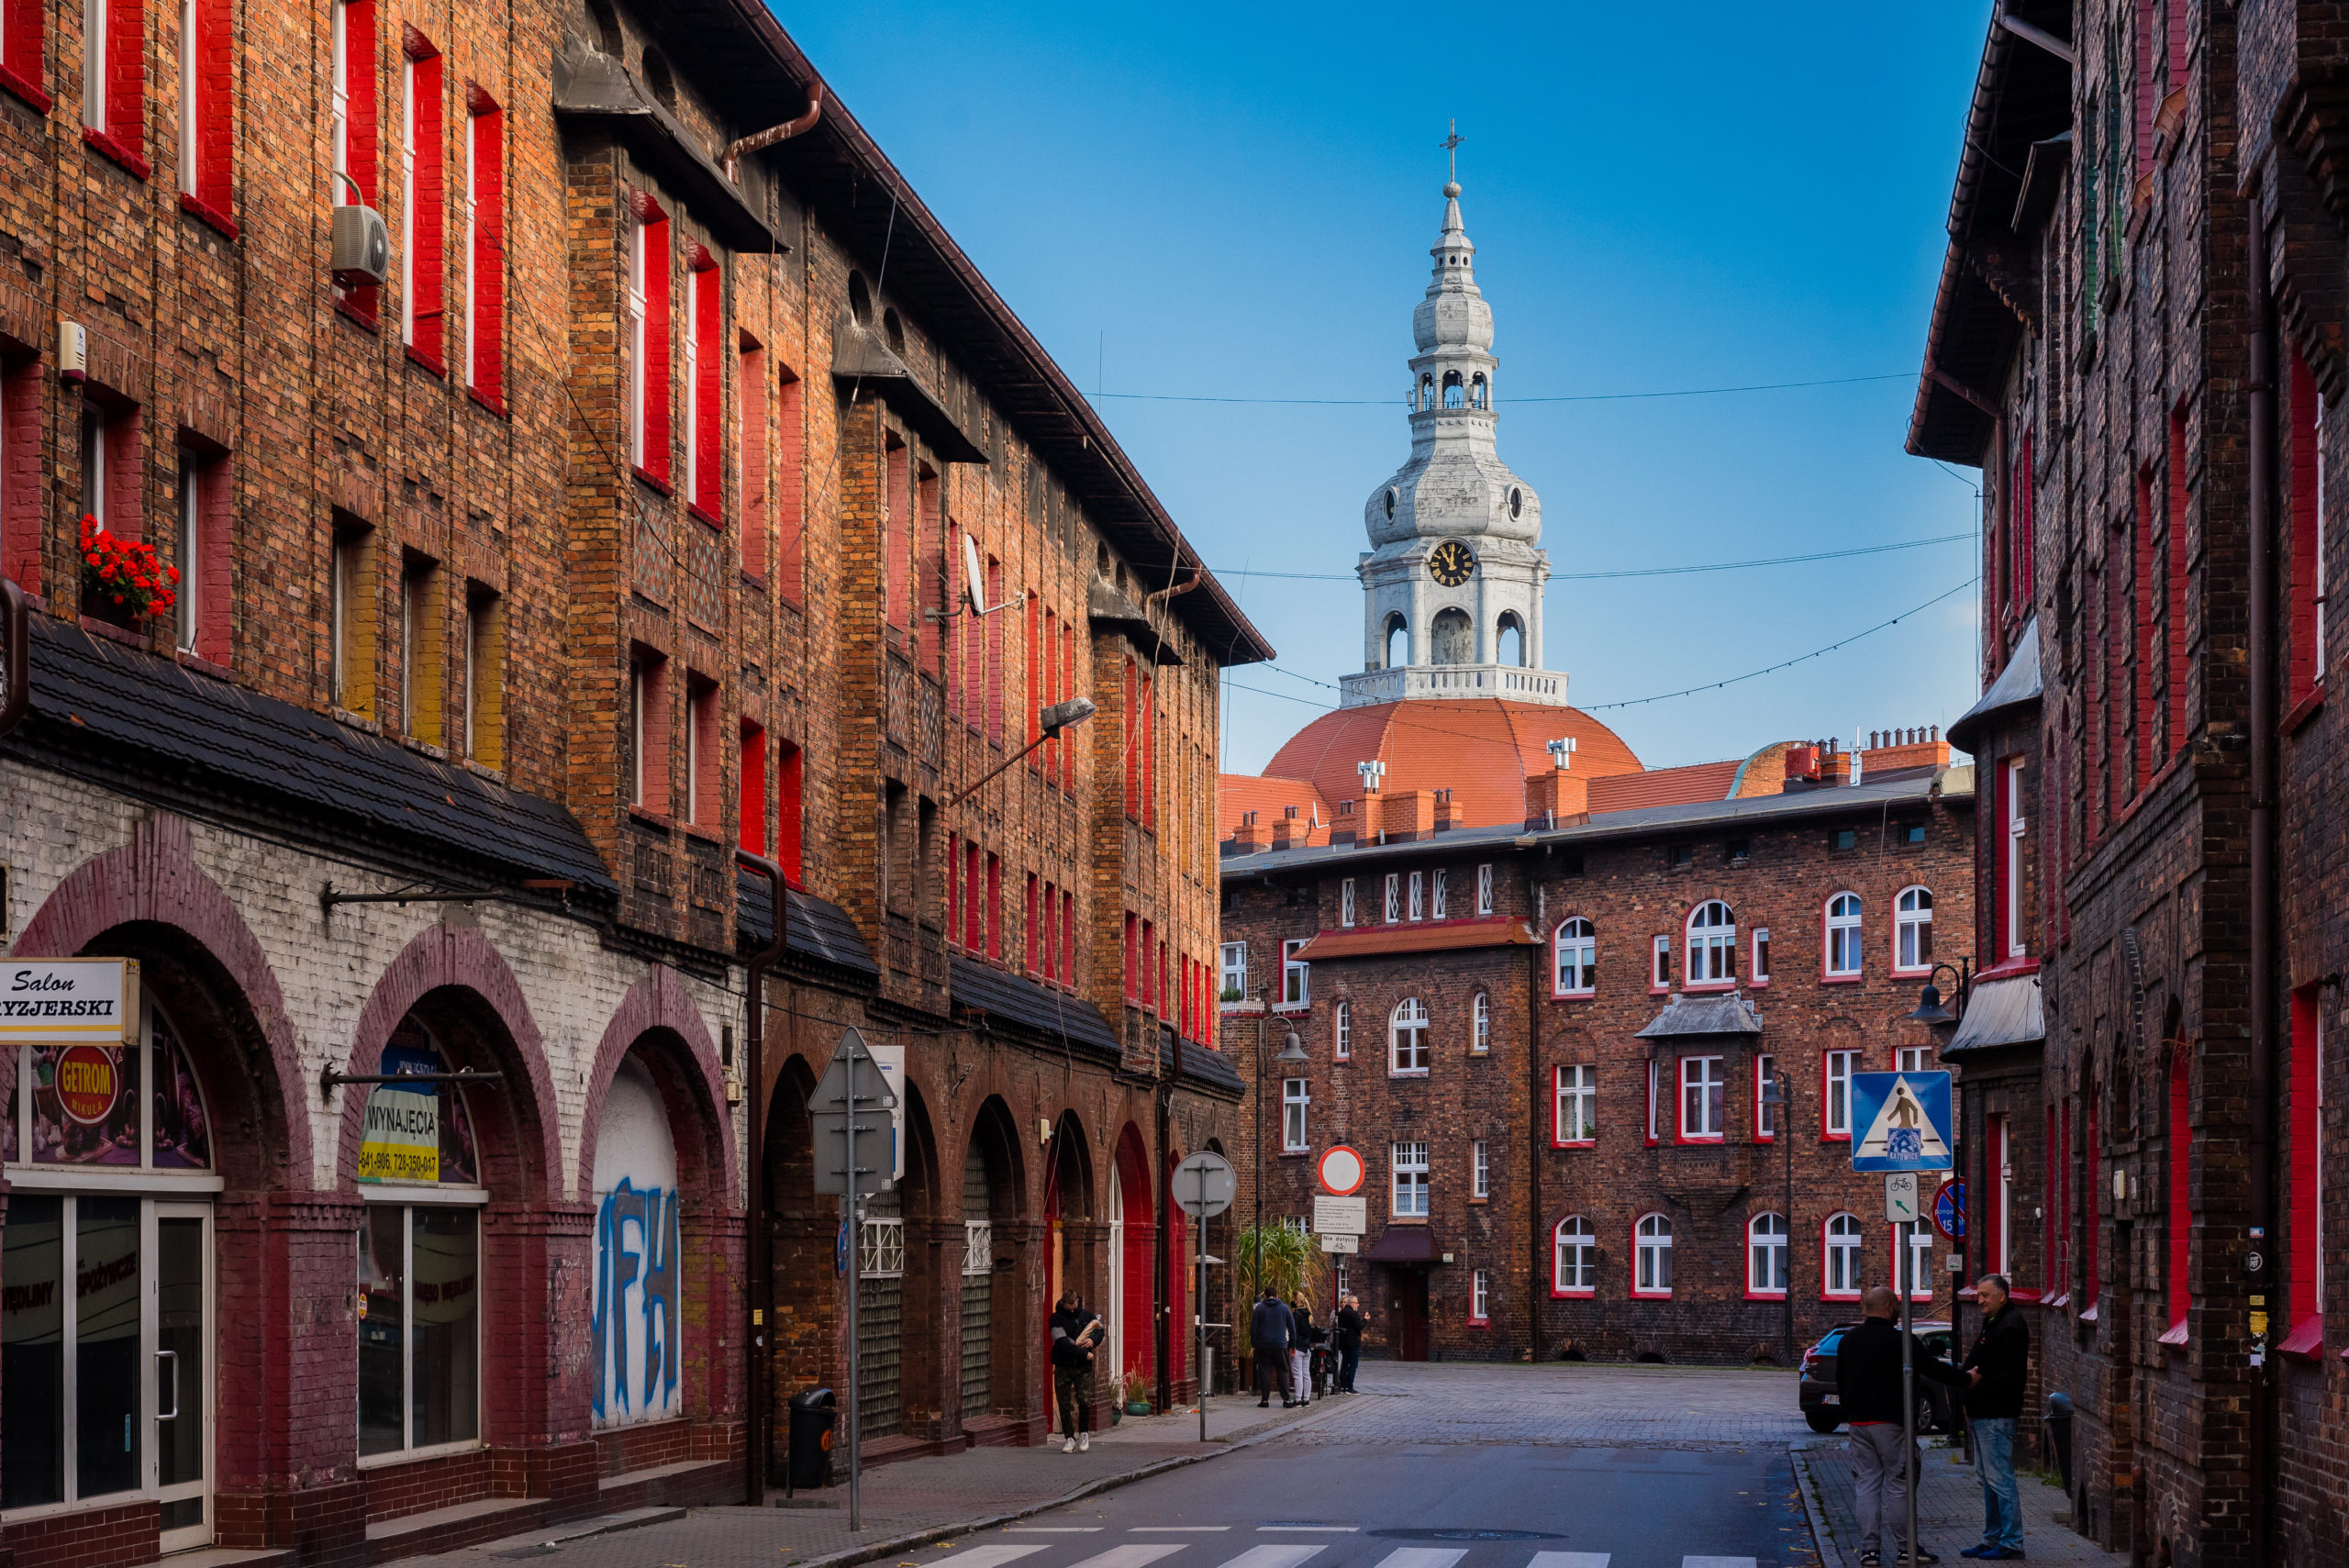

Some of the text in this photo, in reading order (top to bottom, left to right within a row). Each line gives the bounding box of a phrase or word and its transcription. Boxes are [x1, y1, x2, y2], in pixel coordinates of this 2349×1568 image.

[11, 970, 75, 992] Salon
[0, 1000, 115, 1017] YZJERSKI
[61, 1061, 111, 1095] GETROM
[368, 1106, 436, 1140] WYNAJĘCIA
[394, 1153, 436, 1173] 728-350-017
[1943, 1219, 1954, 1231] 15
[1335, 1236, 1357, 1244] dotyczy
